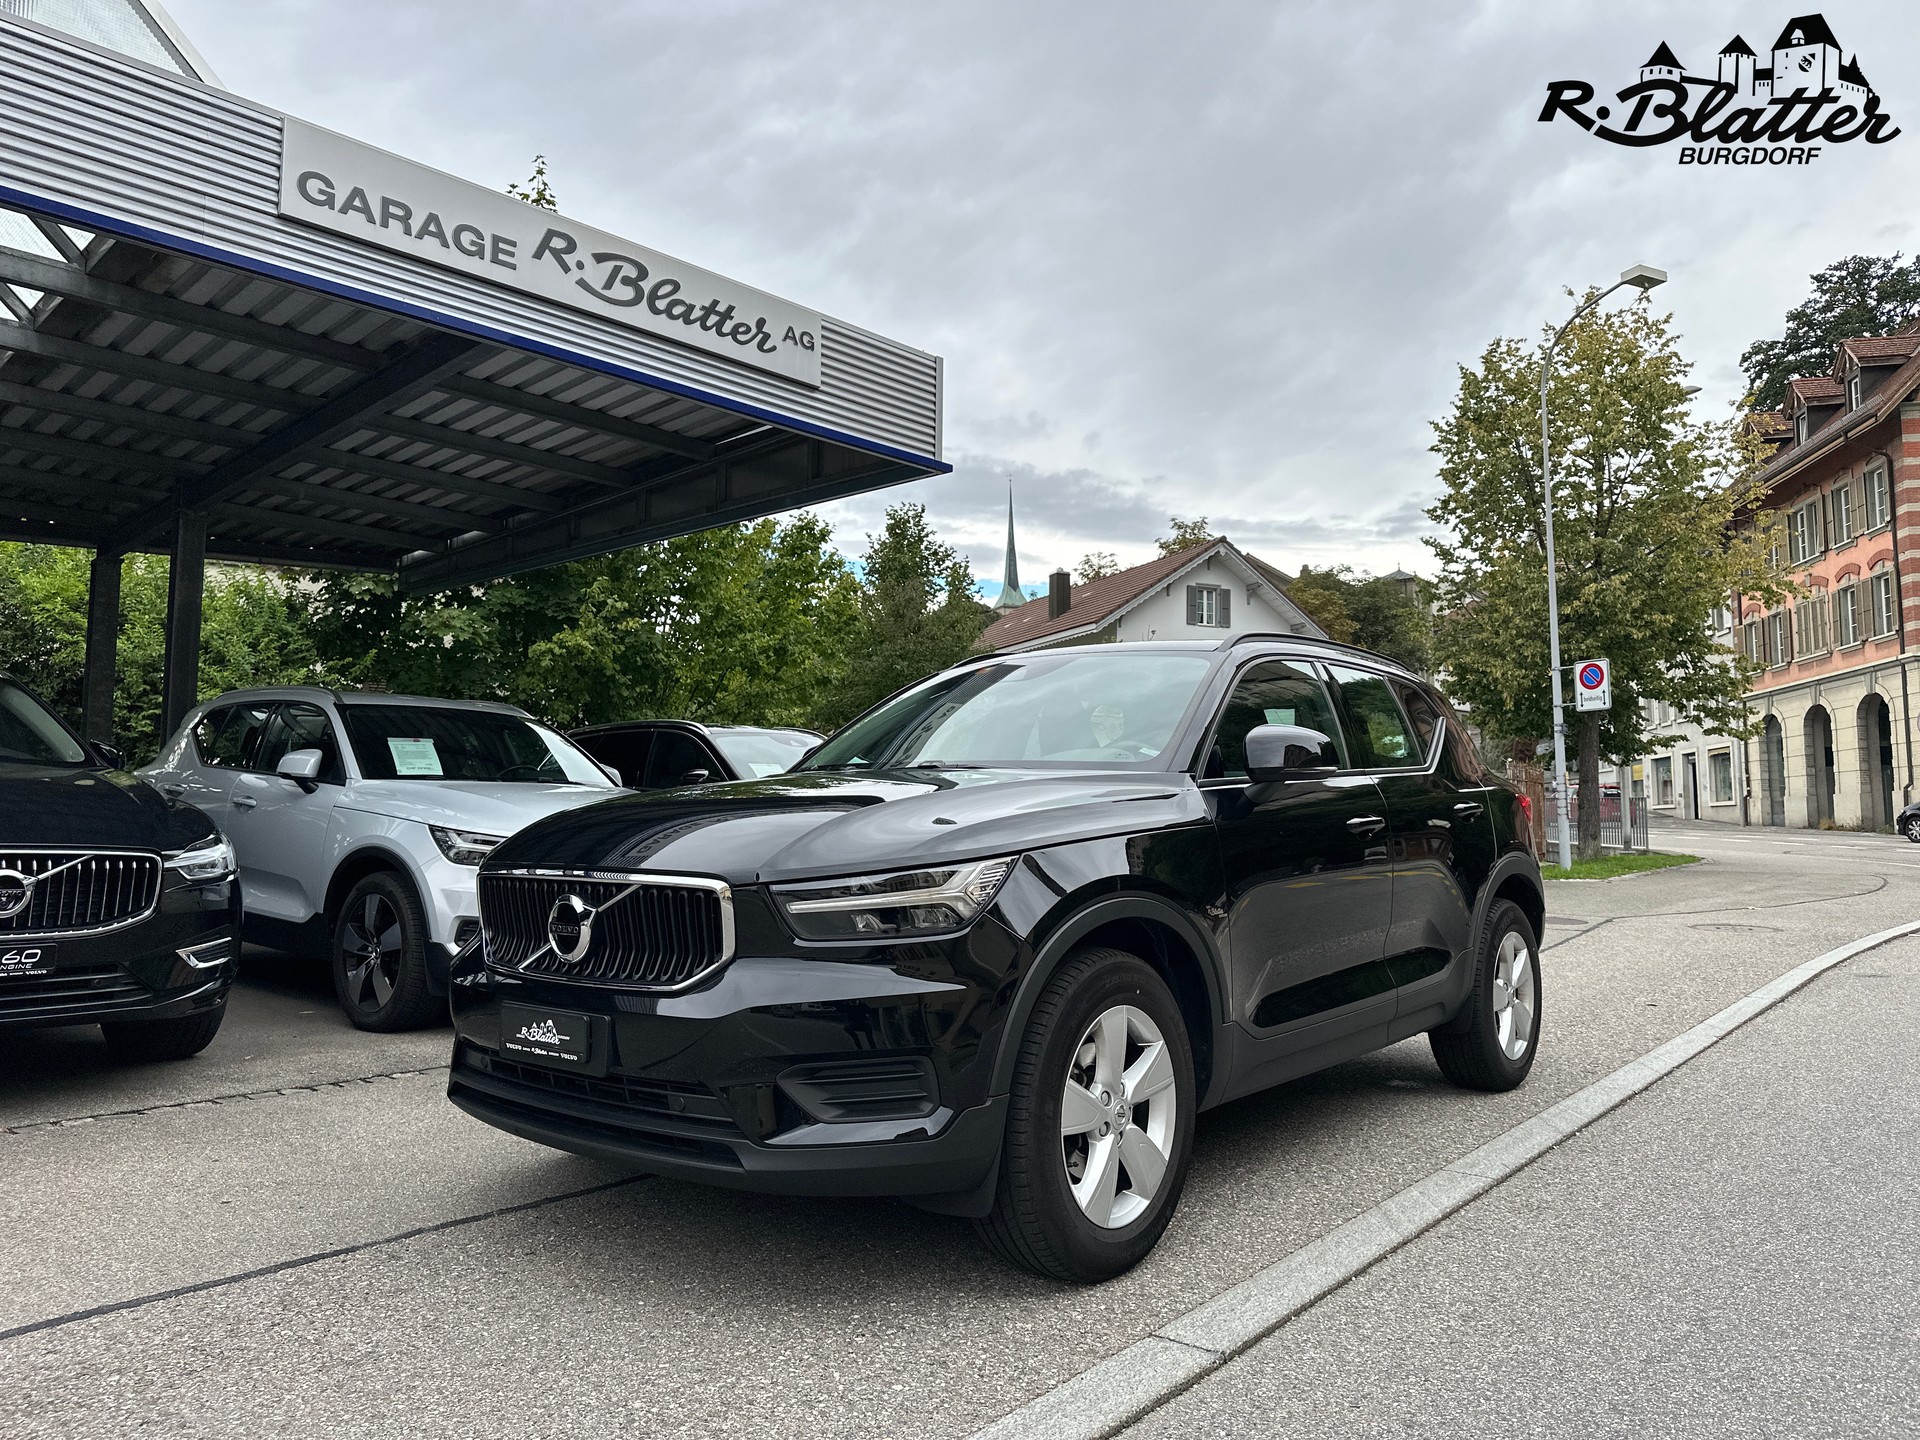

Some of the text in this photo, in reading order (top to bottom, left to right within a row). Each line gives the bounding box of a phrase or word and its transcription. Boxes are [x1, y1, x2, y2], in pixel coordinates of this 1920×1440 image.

[296, 170, 518, 271] GARAGE
[782, 326, 815, 351] AG
[551, 924, 579, 934] VOLVO
[2, 949, 41, 963] 60
